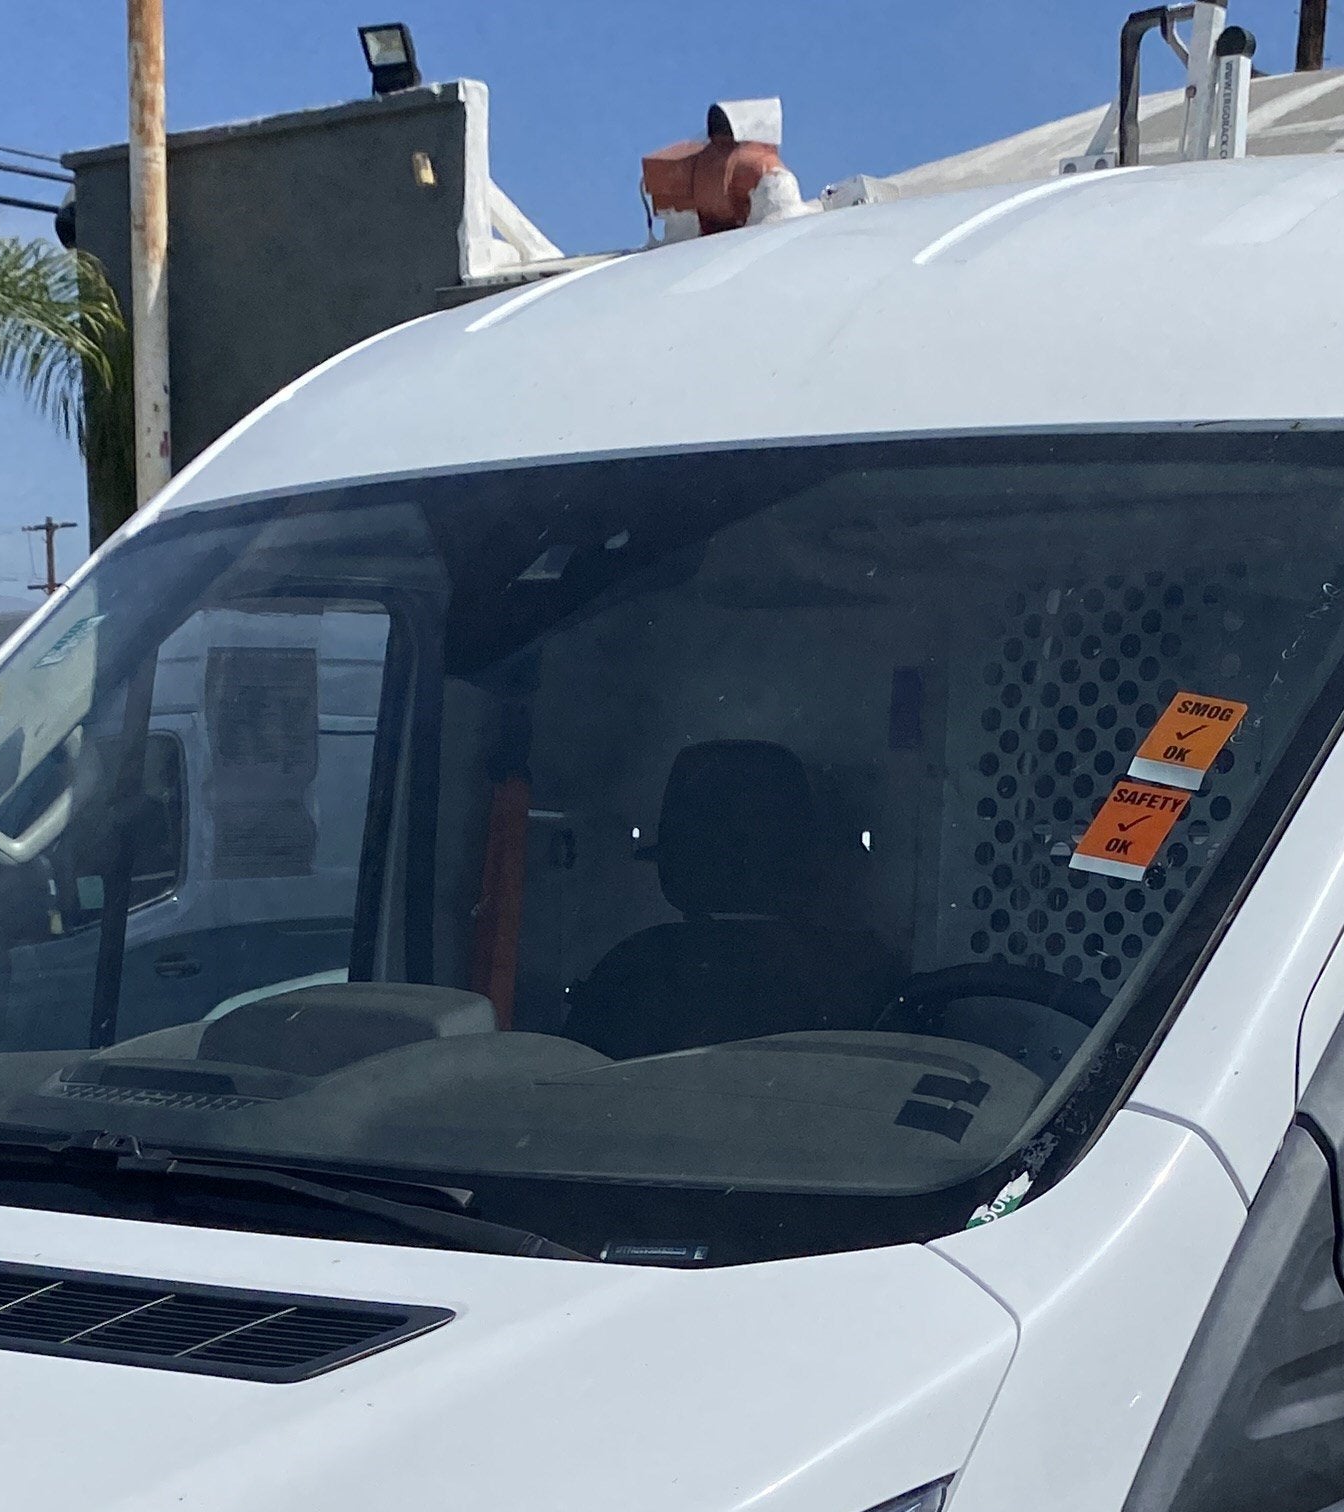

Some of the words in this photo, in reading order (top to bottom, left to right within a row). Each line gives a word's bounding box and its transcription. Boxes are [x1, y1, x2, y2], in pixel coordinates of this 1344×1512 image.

[1177, 700, 1234, 722] SMOG
[1162, 745, 1192, 762] OK
[1113, 788, 1185, 812] SAFETY
[1105, 837, 1133, 855] OK
